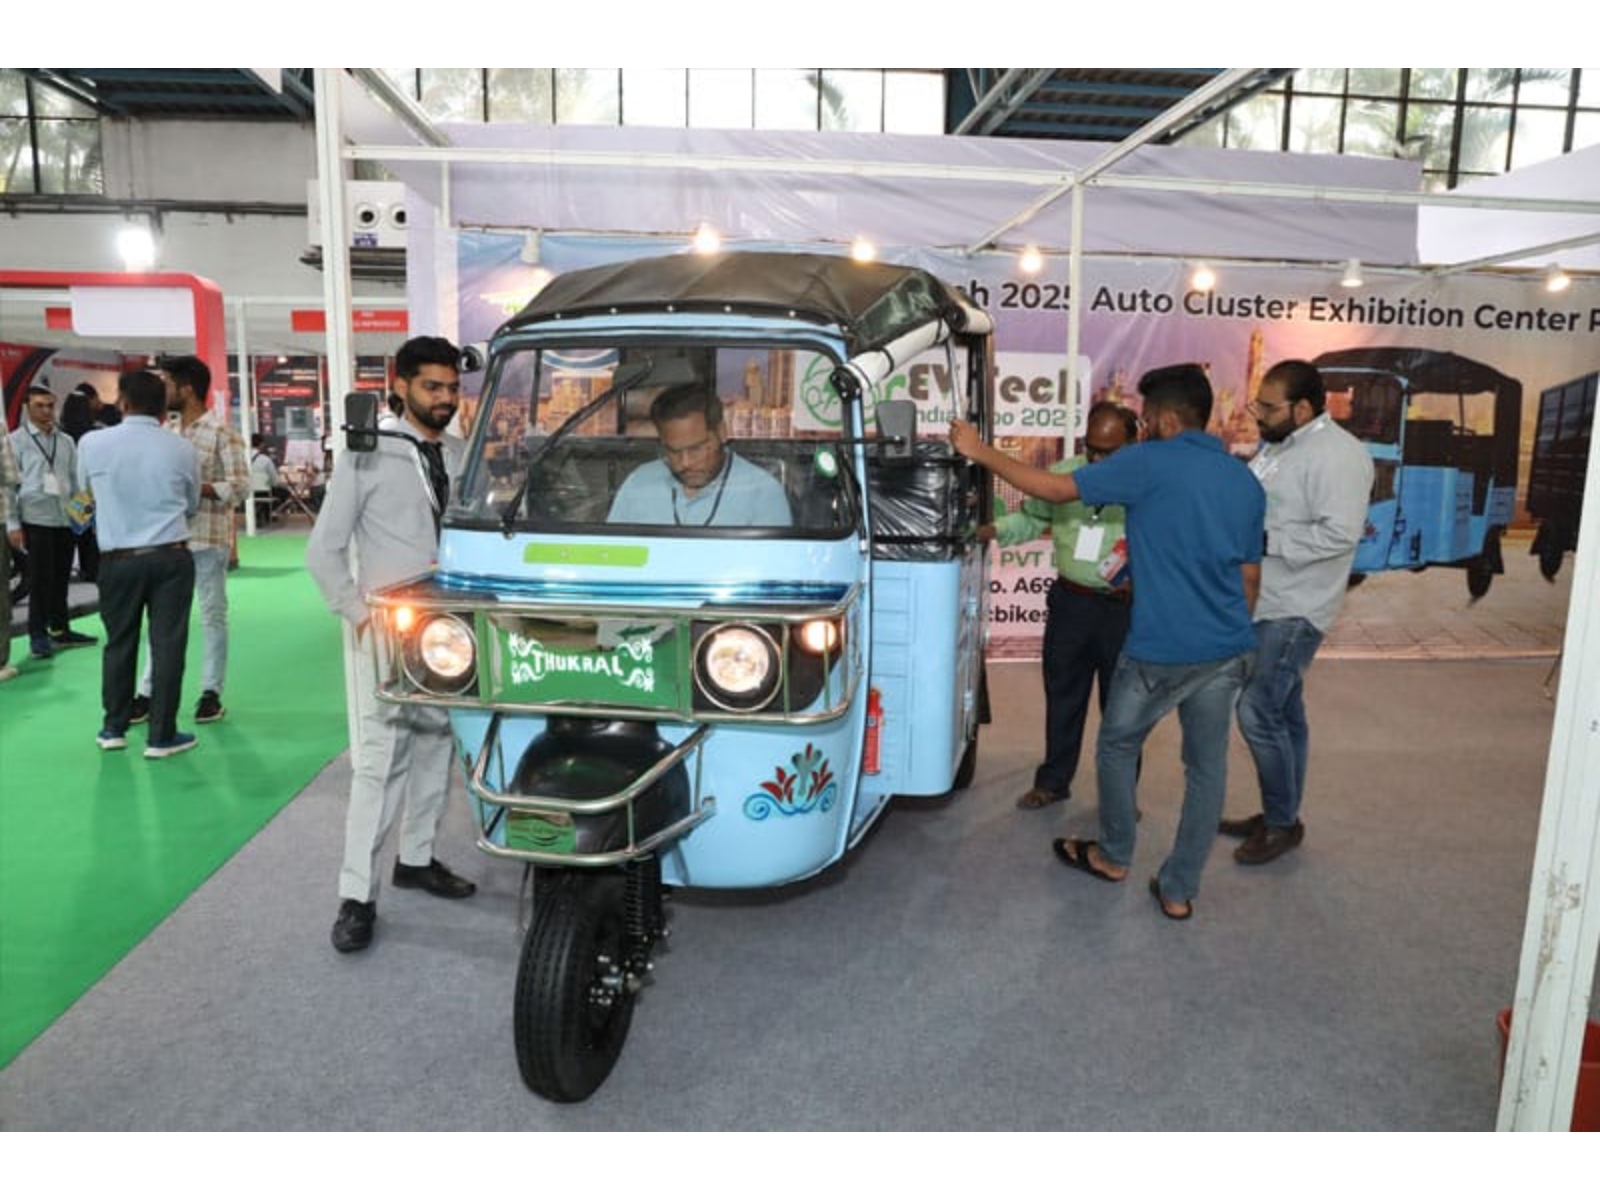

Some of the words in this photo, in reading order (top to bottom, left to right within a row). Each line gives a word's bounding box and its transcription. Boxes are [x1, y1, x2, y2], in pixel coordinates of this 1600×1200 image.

[1091, 286, 1173, 313] Auto
[1183, 289, 1298, 320] Cluster
[1309, 296, 1464, 328] Exhibition
[1474, 304, 1581, 332] Center
[994, 366, 1081, 405] ech
[917, 405, 957, 423] ndia
[1001, 551, 1043, 566] PVT
[989, 580, 1006, 594] o.
[989, 604, 1050, 623] bikes
[531, 649, 624, 677] THUKRAL
